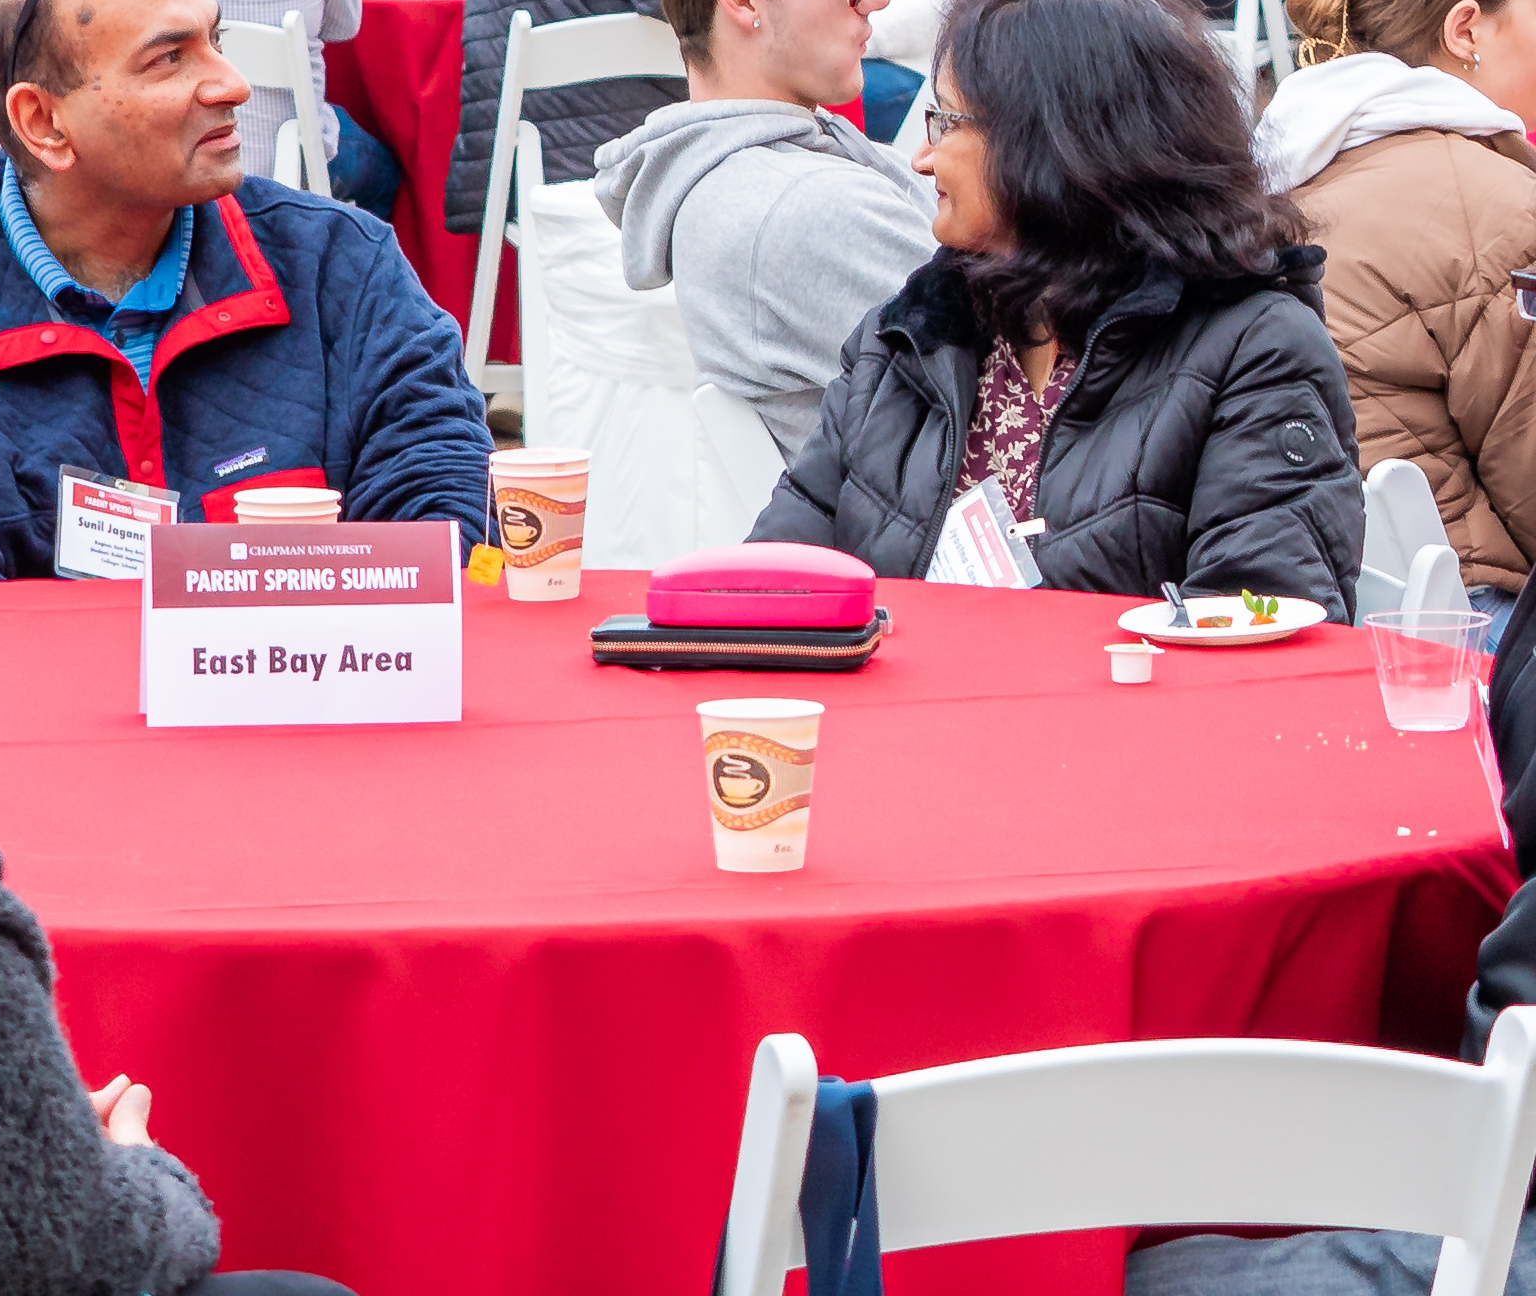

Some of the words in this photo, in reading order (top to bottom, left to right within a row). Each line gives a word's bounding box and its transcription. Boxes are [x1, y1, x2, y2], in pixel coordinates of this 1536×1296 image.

[217, 454, 265, 478] patagonia
[78, 517, 104, 532] Sunil
[249, 545, 305, 556] CHAPMAN
[308, 544, 372, 556] UNIVERSITY
[185, 569, 259, 592] PARENT
[264, 568, 336, 591] SPRING
[341, 566, 420, 589] SUMMIT
[193, 647, 257, 675] East
[268, 645, 327, 682] Bay
[338, 644, 413, 673] Area
